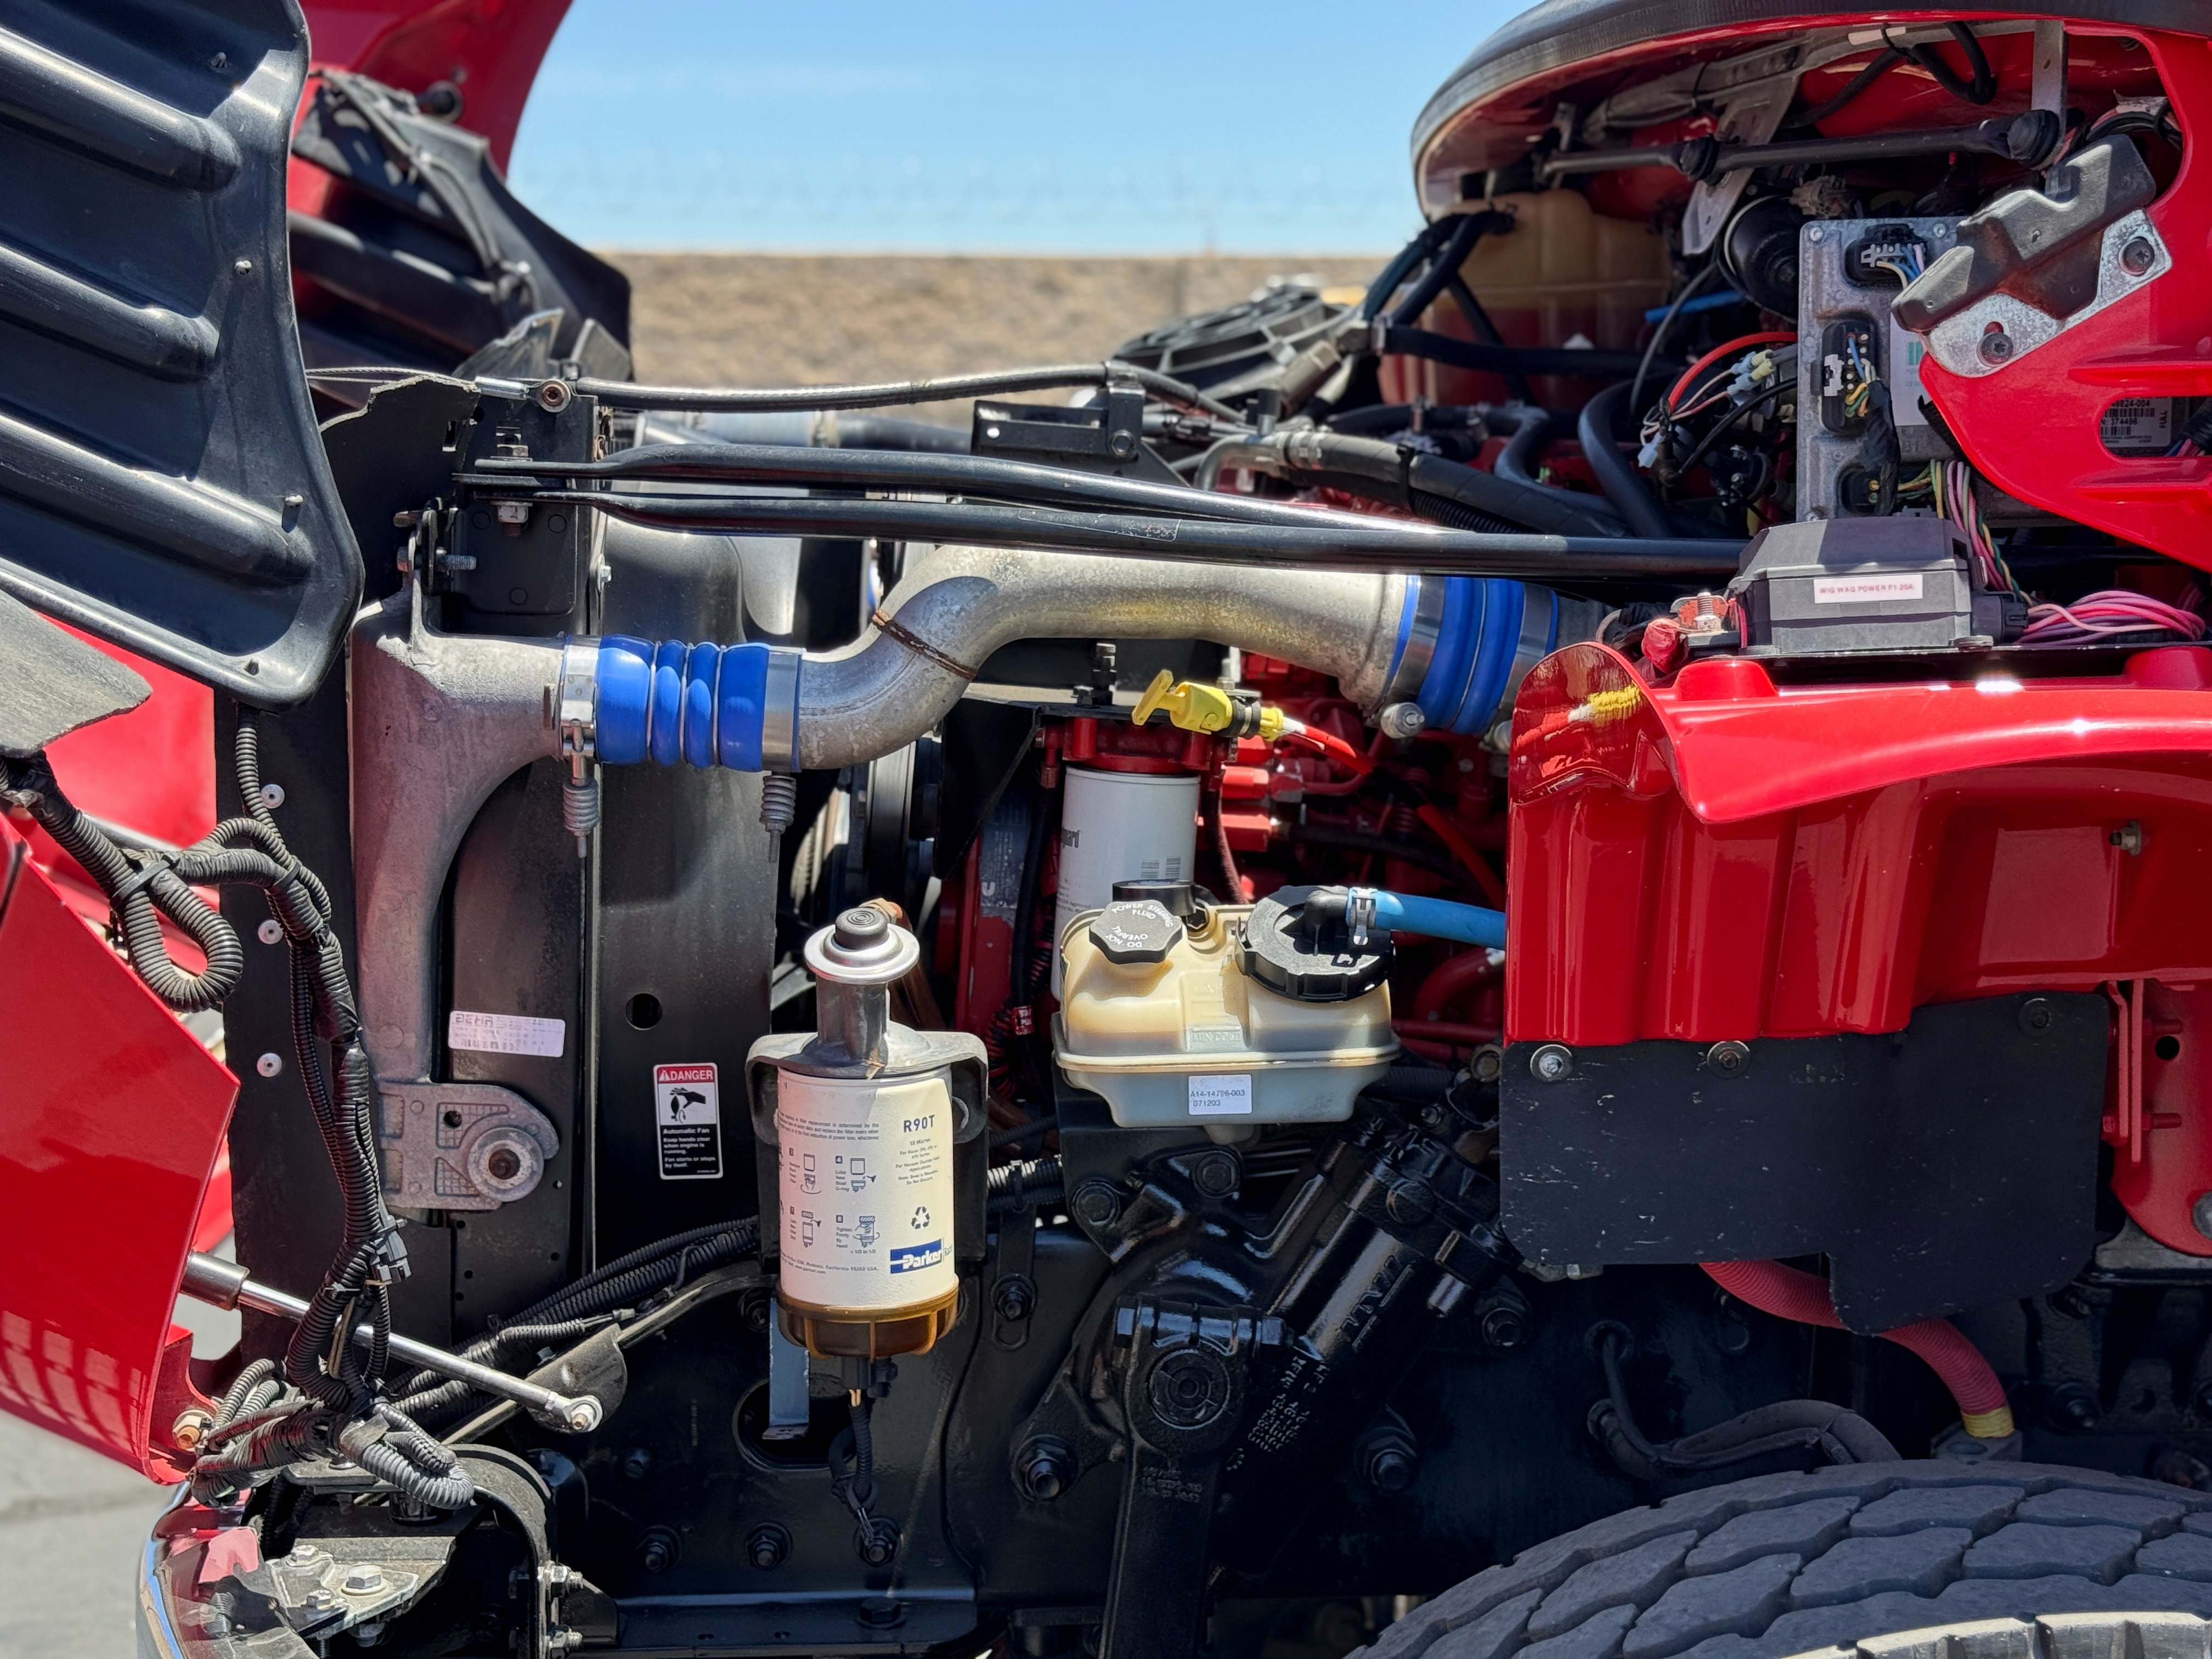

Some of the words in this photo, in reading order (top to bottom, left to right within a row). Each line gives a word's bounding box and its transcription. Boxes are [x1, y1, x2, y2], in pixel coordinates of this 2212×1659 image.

[1111, 903, 1144, 914] POWER
[1147, 905, 1174, 928] STEERING
[1132, 909, 1156, 919] FLUID
[1105, 933, 1123, 945] NOT
[670, 1070, 713, 1081] DANGER
[904, 1114, 935, 1132] R90T
[901, 1250, 942, 1269] Parker
